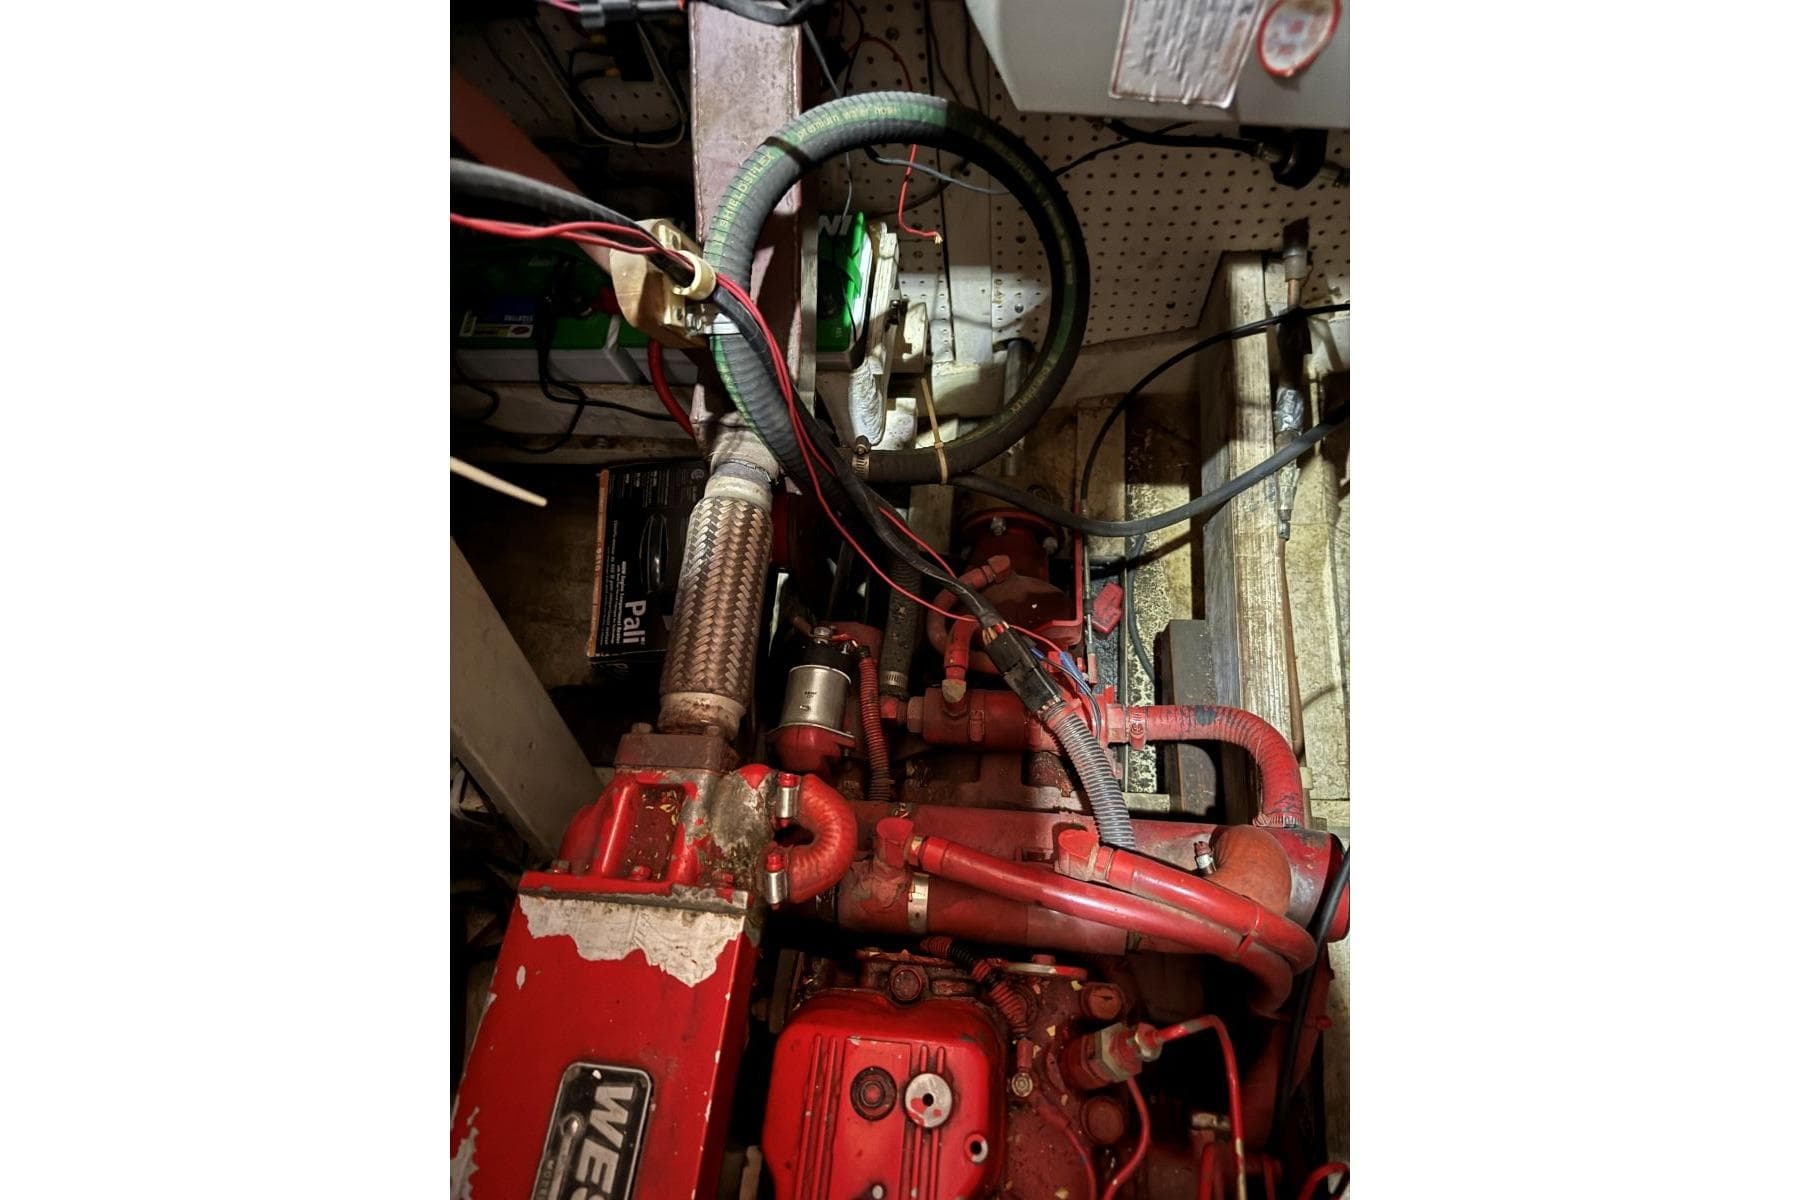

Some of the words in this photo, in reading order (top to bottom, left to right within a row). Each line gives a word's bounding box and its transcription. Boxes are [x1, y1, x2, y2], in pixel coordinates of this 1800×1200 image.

[797, 113, 840, 141] premium
[842, 105, 870, 120] water
[623, 600, 647, 644] Pali
